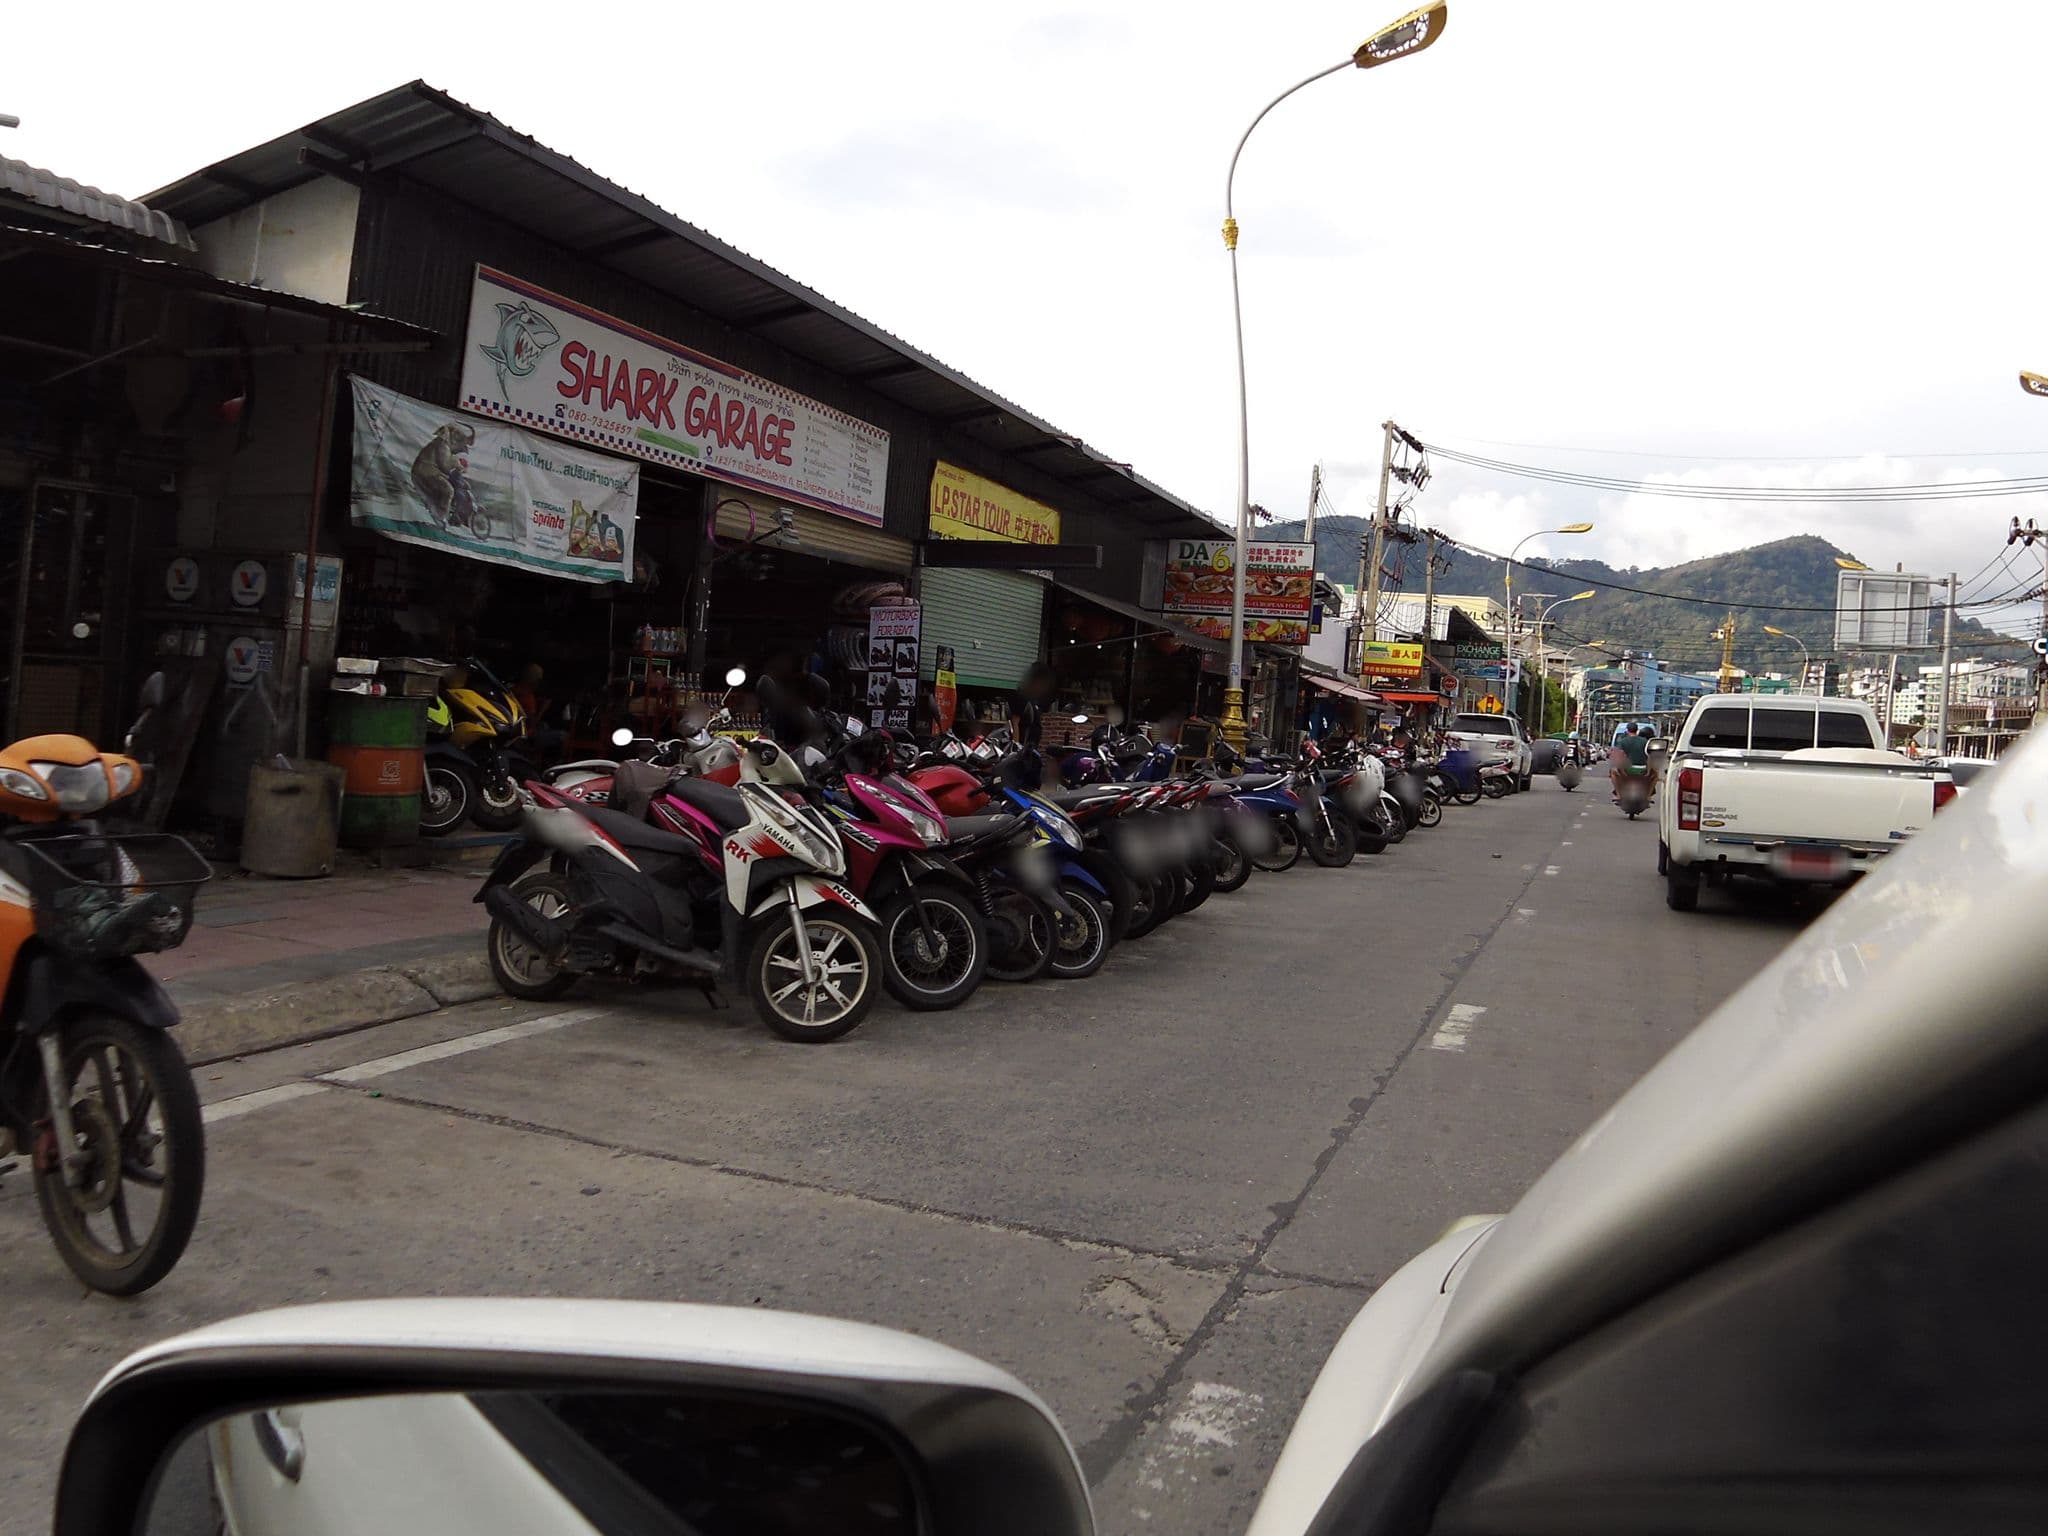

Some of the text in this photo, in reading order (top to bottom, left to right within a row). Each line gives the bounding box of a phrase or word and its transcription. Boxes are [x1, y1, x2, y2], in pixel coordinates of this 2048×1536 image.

[557, 340, 796, 466] SHARK GARAGE
[568, 408, 632, 435] 080-7325857
[984, 499, 1010, 536] TOUR
[1179, 542, 1209, 560] DA
[1212, 547, 1231, 573] 6
[1456, 644, 1502, 655] EXCHANGE
[762, 823, 796, 852] YAMAHA
[725, 839, 752, 864] RK
[832, 885, 861, 908] NGK
